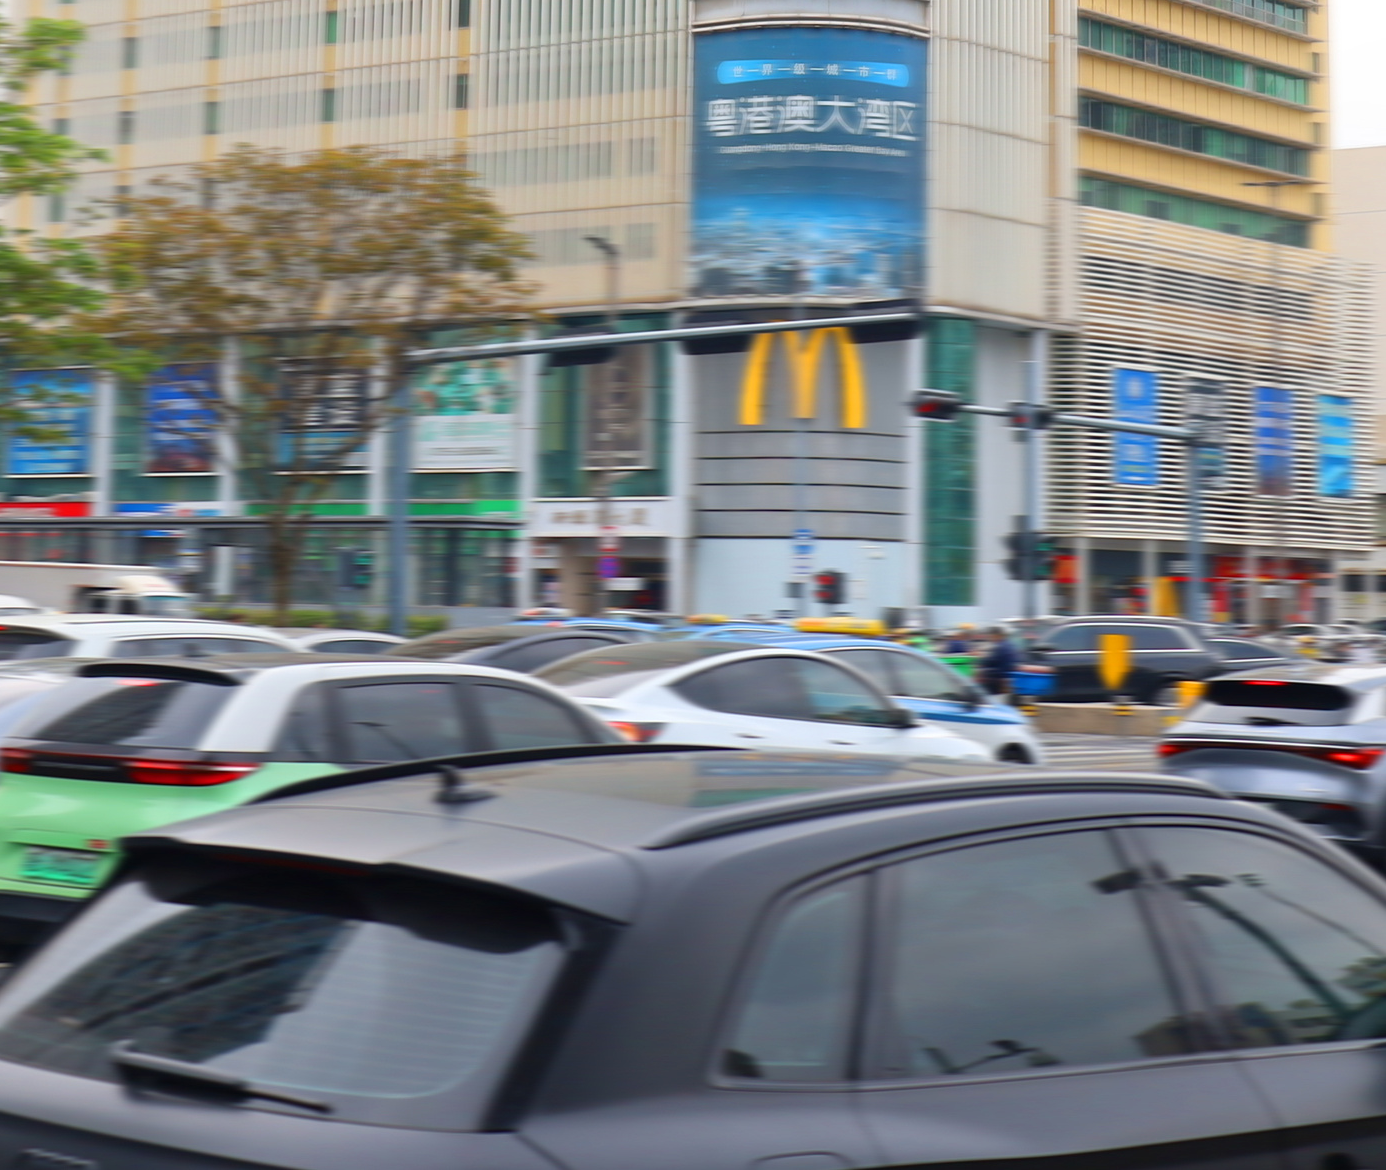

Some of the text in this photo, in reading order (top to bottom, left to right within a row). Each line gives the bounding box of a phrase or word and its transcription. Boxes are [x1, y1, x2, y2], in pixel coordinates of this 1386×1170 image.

[705, 95, 919, 141] 粤港澳大湾区
